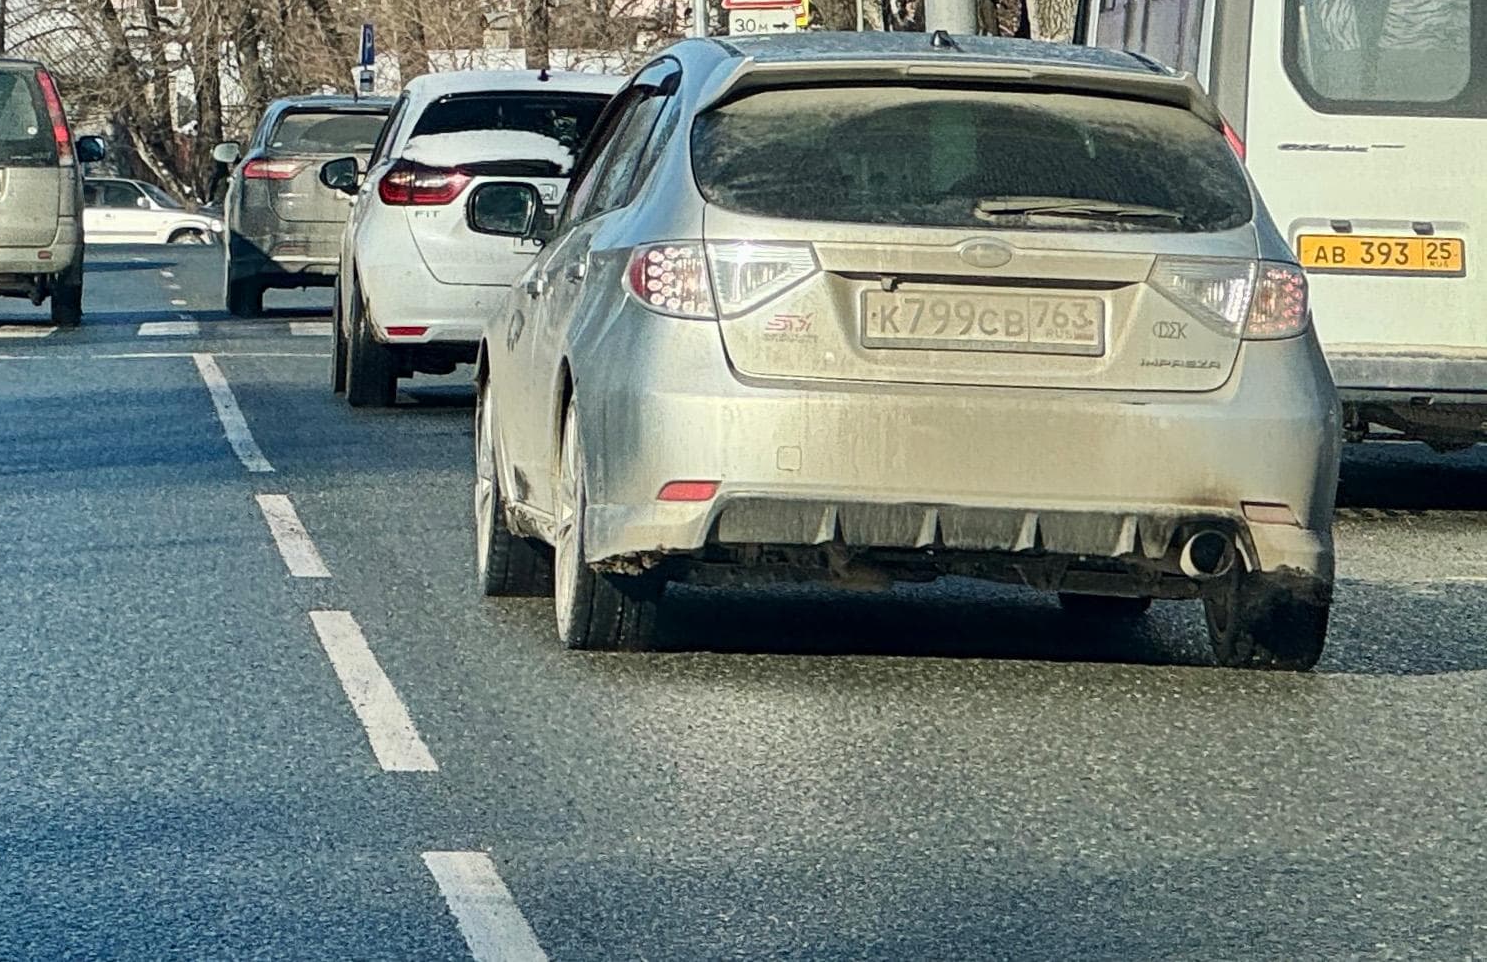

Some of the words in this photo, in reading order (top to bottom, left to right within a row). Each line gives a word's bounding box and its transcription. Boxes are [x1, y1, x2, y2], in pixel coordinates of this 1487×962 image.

[414, 210, 441, 218] FIT
[1360, 241, 1409, 266] 393
[1426, 242, 1452, 260] 25
[1031, 300, 1089, 329] 763
